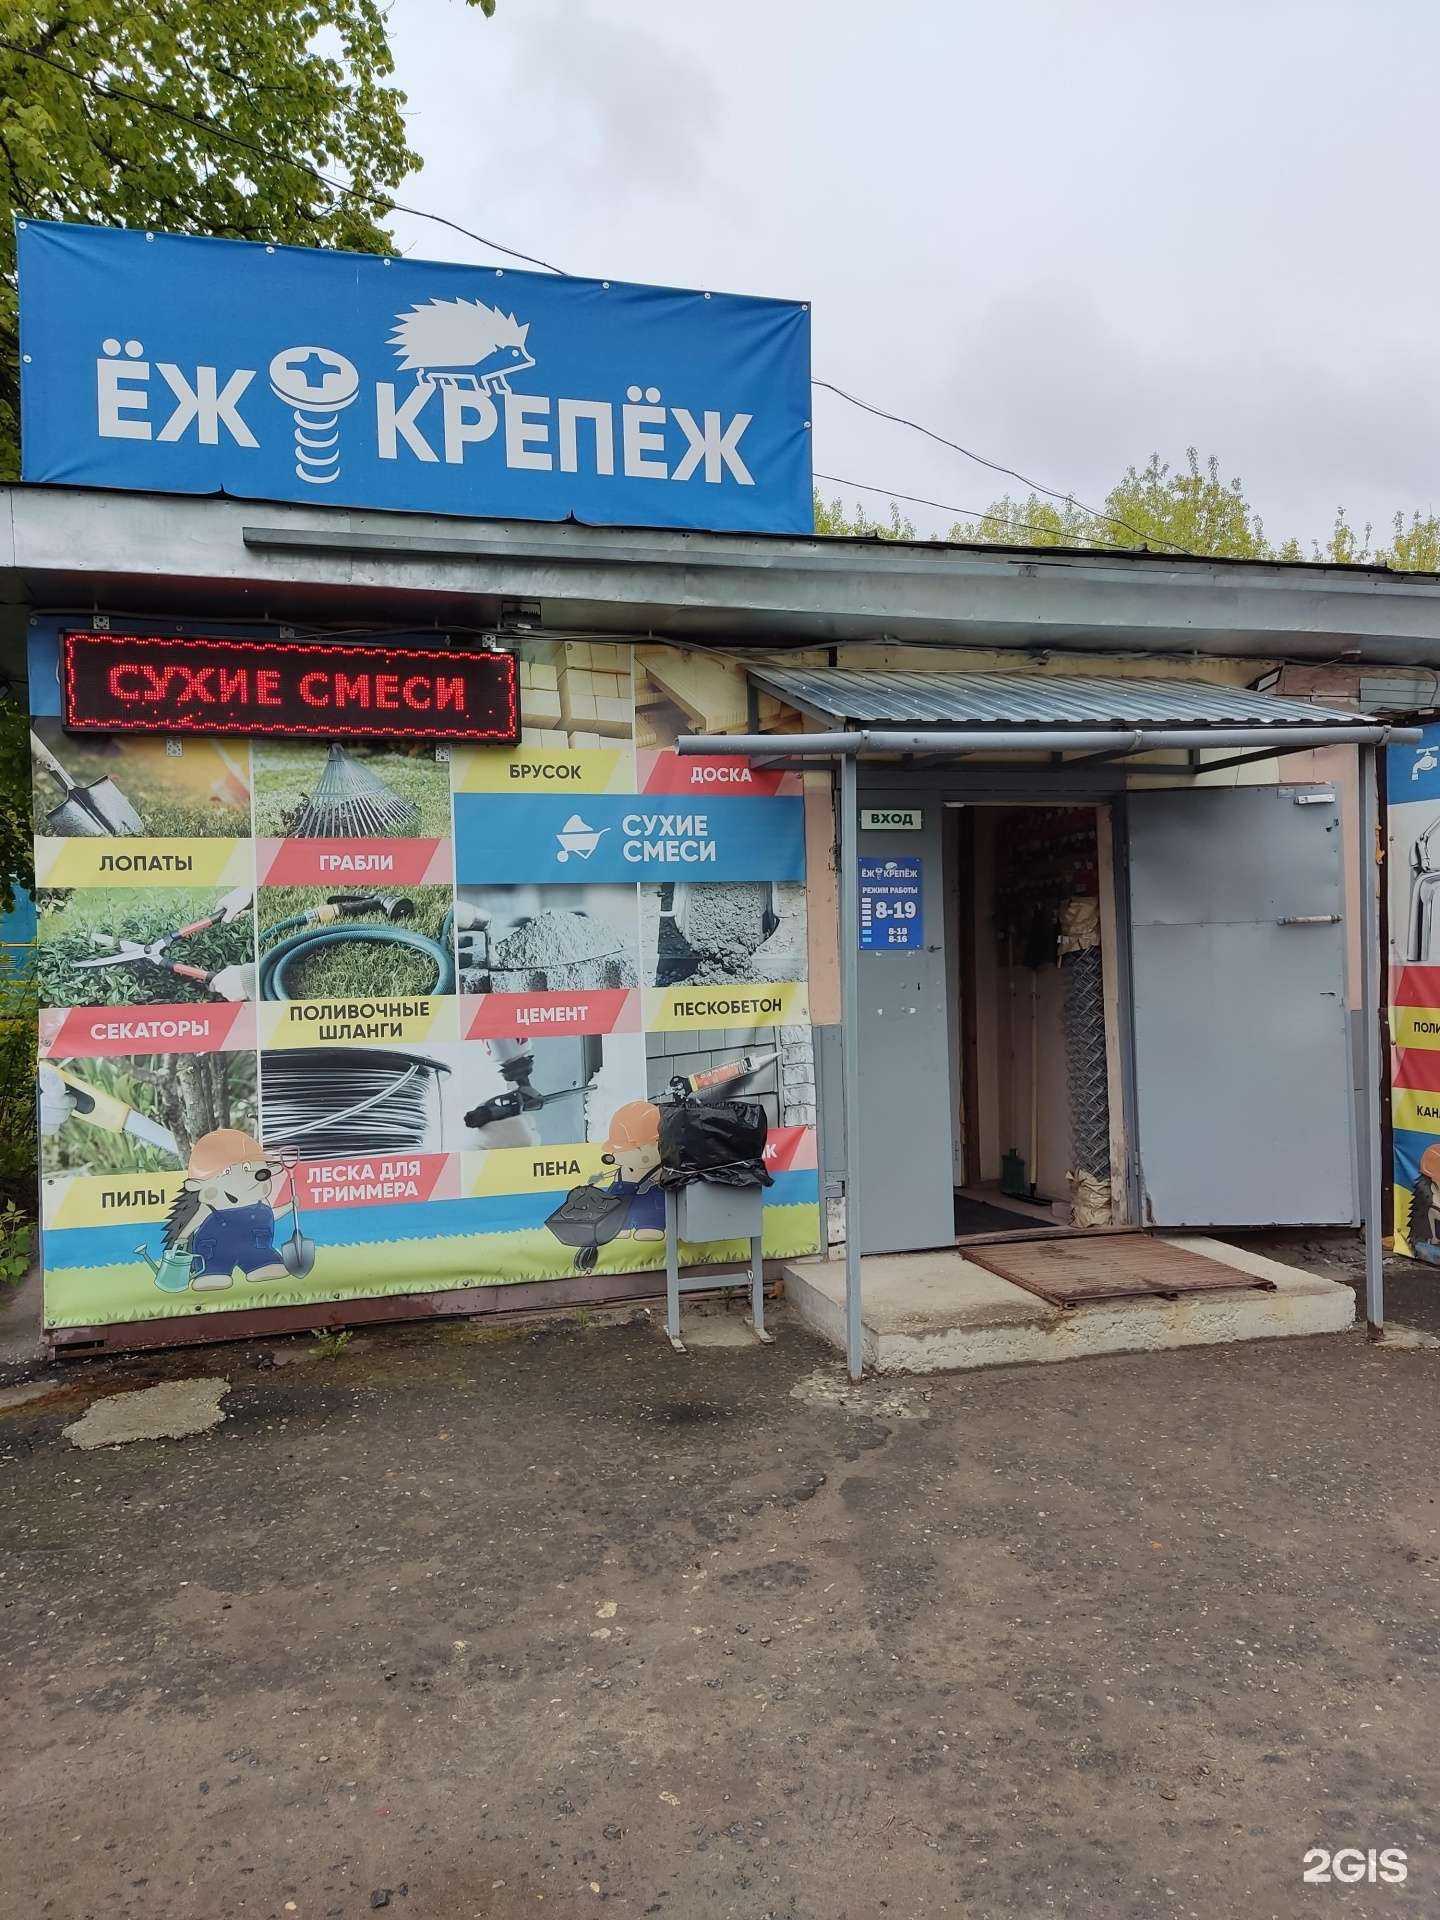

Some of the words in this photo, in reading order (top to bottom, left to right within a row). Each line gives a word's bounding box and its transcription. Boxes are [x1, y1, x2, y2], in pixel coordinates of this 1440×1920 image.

[96, 337, 260, 449] ЁЖ
[376, 382, 757, 486] КРЕПЁЖ
[107, 664, 283, 705] СУХИЕ
[298, 671, 466, 712] СМЕСИ
[508, 763, 582, 780] БРУСОК
[689, 766, 753, 784] ДОСКА
[622, 814, 709, 838] СУХИЕ
[871, 813, 914, 826] ВХОД
[623, 839, 717, 863] СМЕСИ
[99, 854, 194, 874] ЛОПАТЫ
[318, 854, 394, 873] ГРАБЛИ
[861, 867, 875, 879] ЁЖ
[883, 867, 918, 879] КРЕПЁЖ
[862, 886, 889, 895] РЕЖИМ
[889, 886, 918, 895] РАБОТЫ
[875, 901, 917, 919] 8-19
[888, 927, 908, 935] 8-18
[888, 935, 908, 943] 8-16
[289, 1001, 431, 1022] ПОЛИВОЧНЫЕ
[515, 1005, 590, 1025] ЦЕМЕНТ
[673, 997, 783, 1017] ПЕСКОБЕТОН
[89, 1018, 210, 1041] СЕКАТОРЫ
[318, 1022, 404, 1041] ШЛАНГИ
[1416, 1104, 1440, 1119] КАН
[306, 1163, 376, 1185] ЛЕСКА
[378, 1159, 422, 1182] ДЛЯ
[532, 1160, 581, 1178] ПЕНА
[101, 1189, 166, 1210] ПИЛЫ
[310, 1182, 420, 1205] ТРИММЕРА
